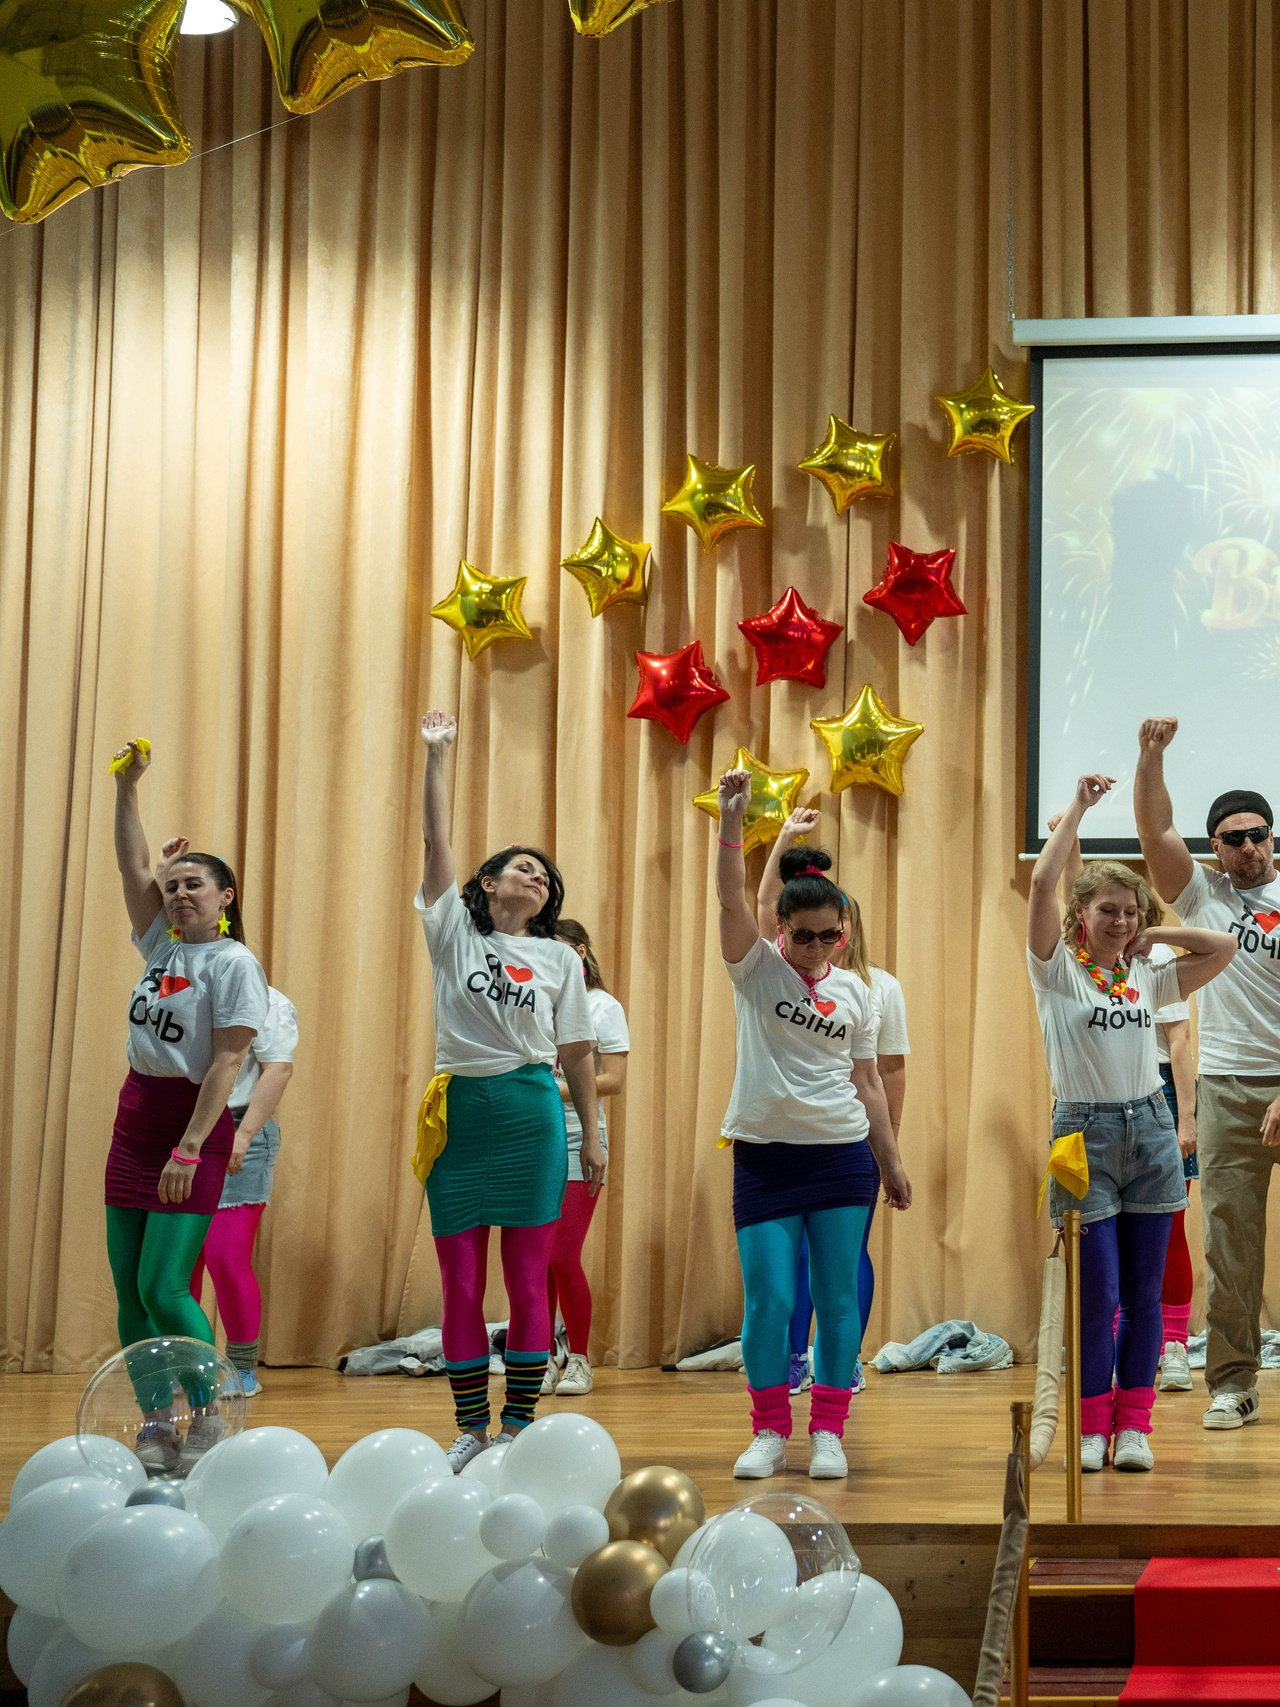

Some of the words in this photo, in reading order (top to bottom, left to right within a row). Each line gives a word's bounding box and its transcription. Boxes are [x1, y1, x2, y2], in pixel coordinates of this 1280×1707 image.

[141, 968, 168, 993] Я
[467, 971, 536, 1013] СЫНА
[129, 990, 184, 1043] ОЧЬ
[775, 1001, 846, 1041] СЫНА
[1088, 1007, 1151, 1031] ДОЧЬ
